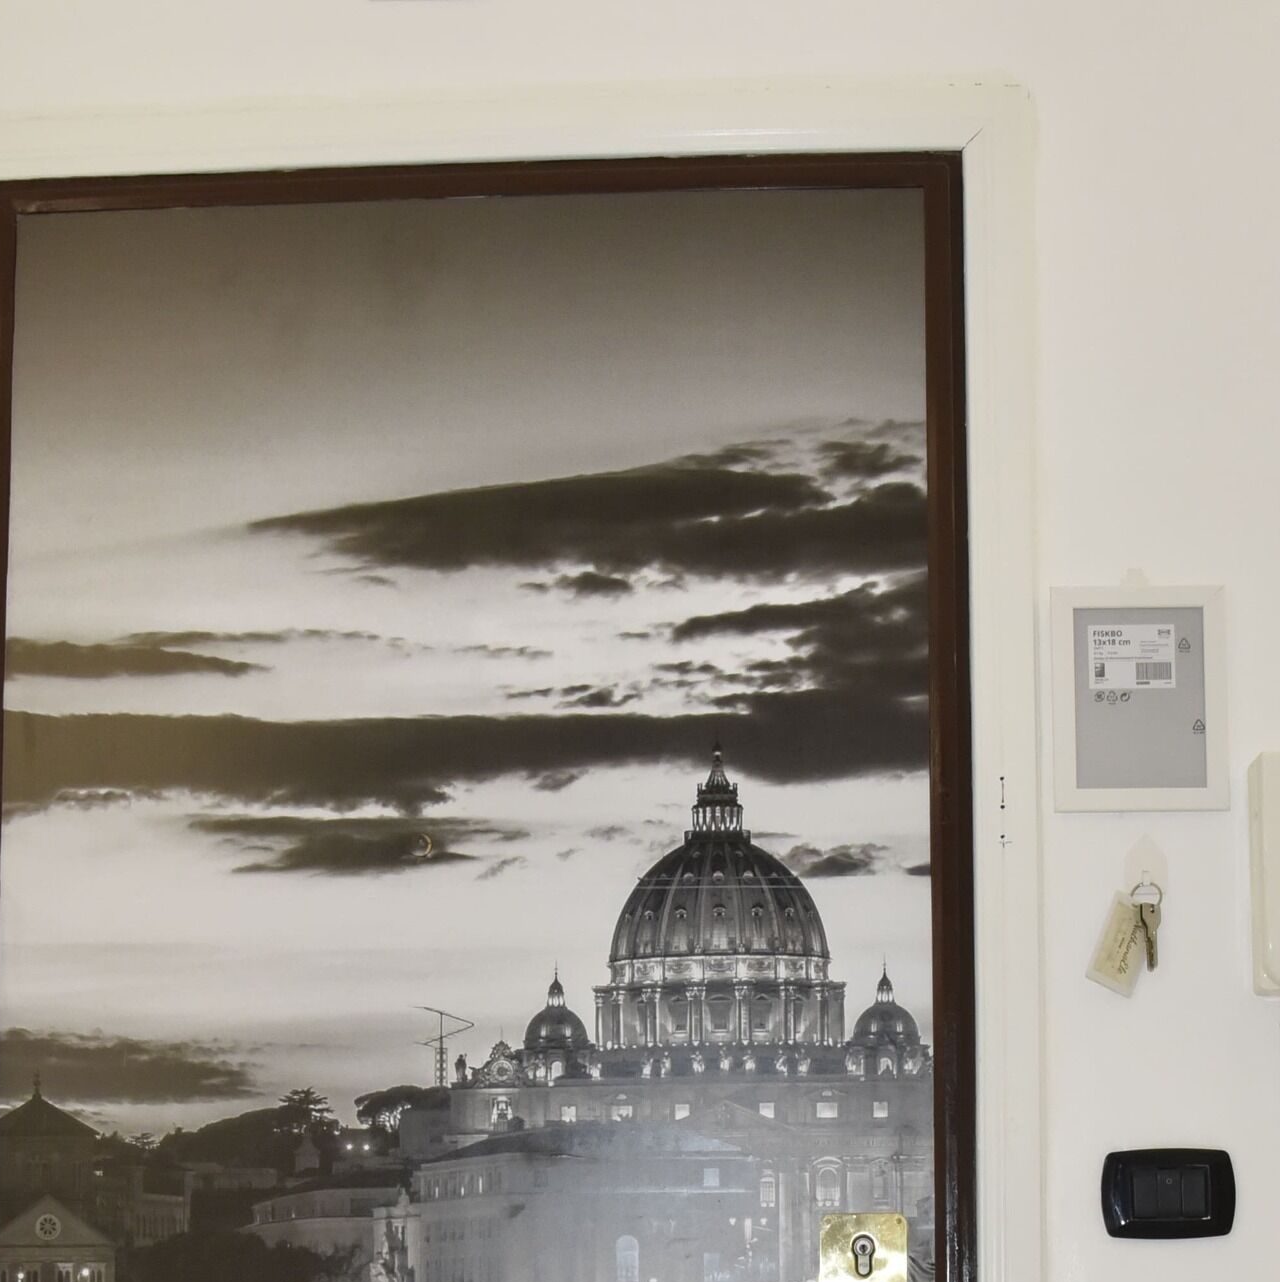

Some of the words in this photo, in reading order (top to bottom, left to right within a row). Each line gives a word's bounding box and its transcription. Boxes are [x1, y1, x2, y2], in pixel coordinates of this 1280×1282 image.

[1093, 630, 1122, 638] FISKBO
[1093, 639, 1116, 647] 13x18
[1118, 639, 1131, 647] cm
